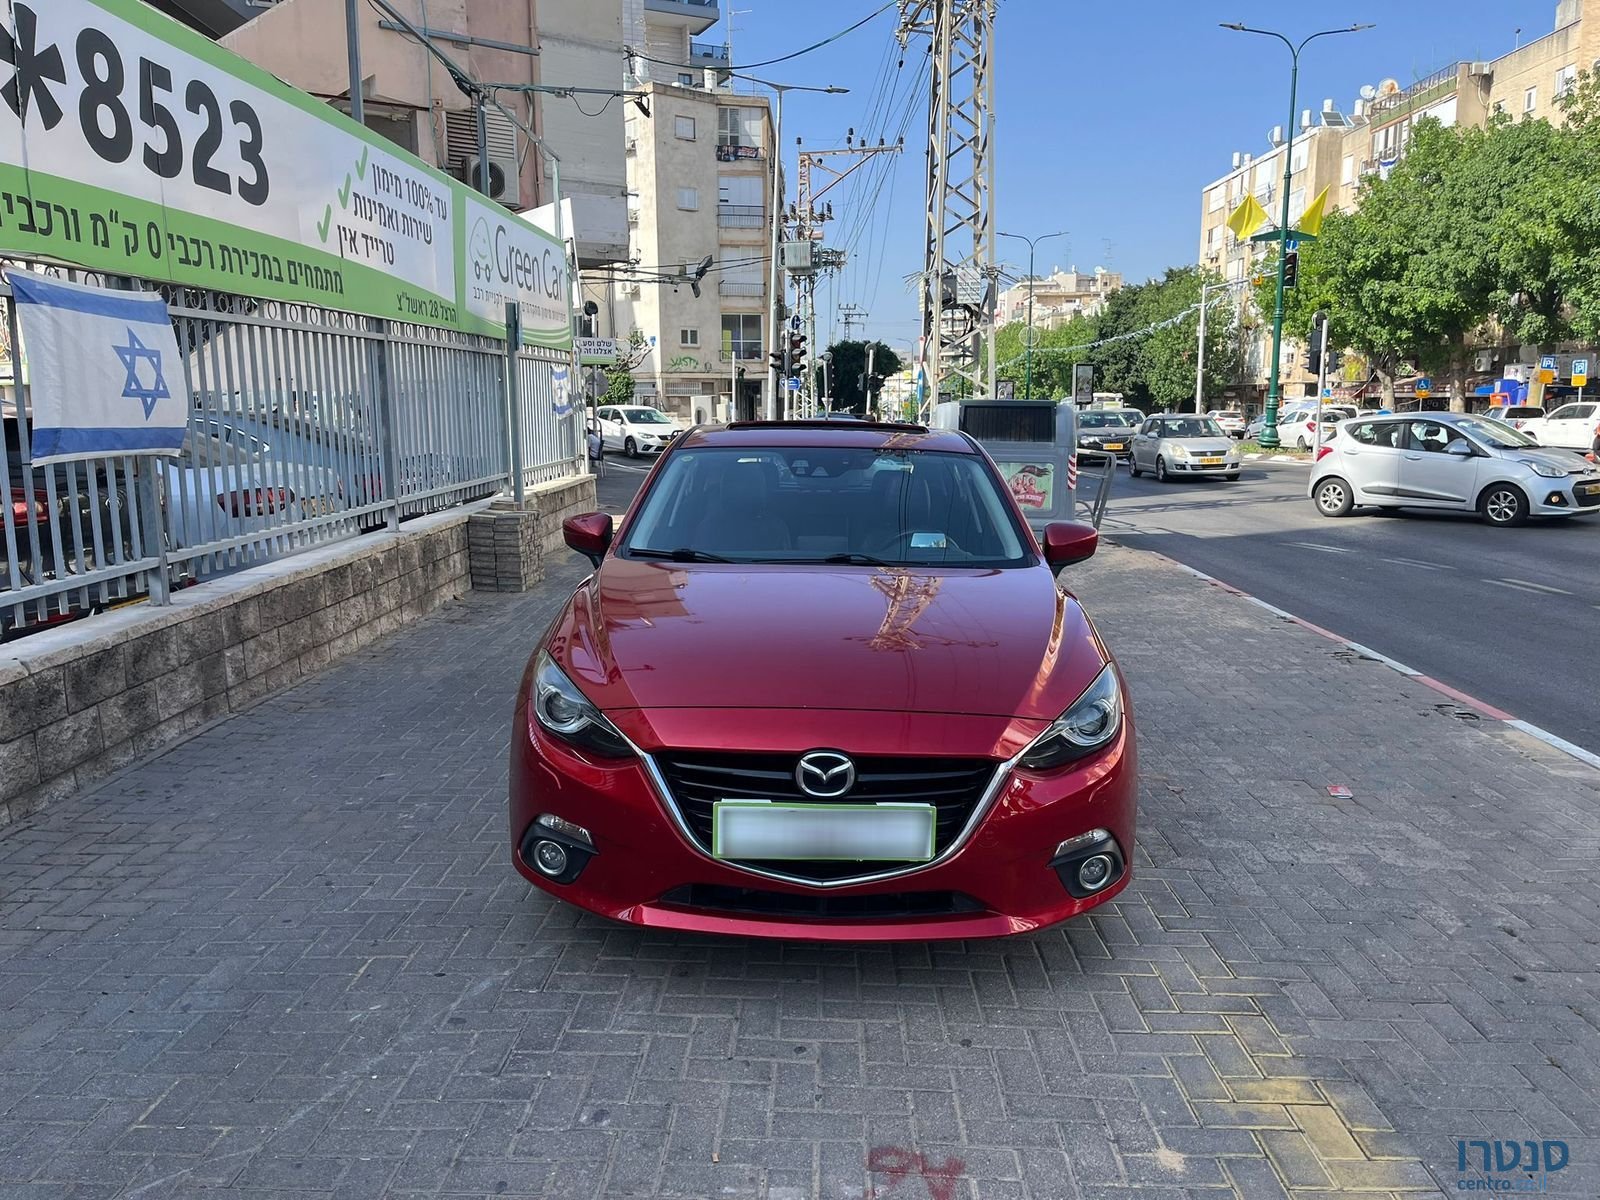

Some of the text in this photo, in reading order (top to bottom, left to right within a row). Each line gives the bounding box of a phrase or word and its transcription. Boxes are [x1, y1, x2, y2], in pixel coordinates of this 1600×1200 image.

[372, 163, 447, 220] עד 100% מימון
[0, 191, 81, 243] ורכבי
[352, 191, 432, 245] שירות ואמינות
[167, 233, 215, 270] רכבי
[218, 243, 284, 283] במכירת
[337, 224, 394, 265] טרייד אין
[495, 224, 563, 301] Green Car
[286, 259, 344, 294] מתמחים
[472, 286, 484, 302] רכב
[428, 299, 439, 319] 28
[440, 301, 457, 323] הרצל
[593, 347, 612, 355] אצלנו
[597, 339, 612, 347] שלם
